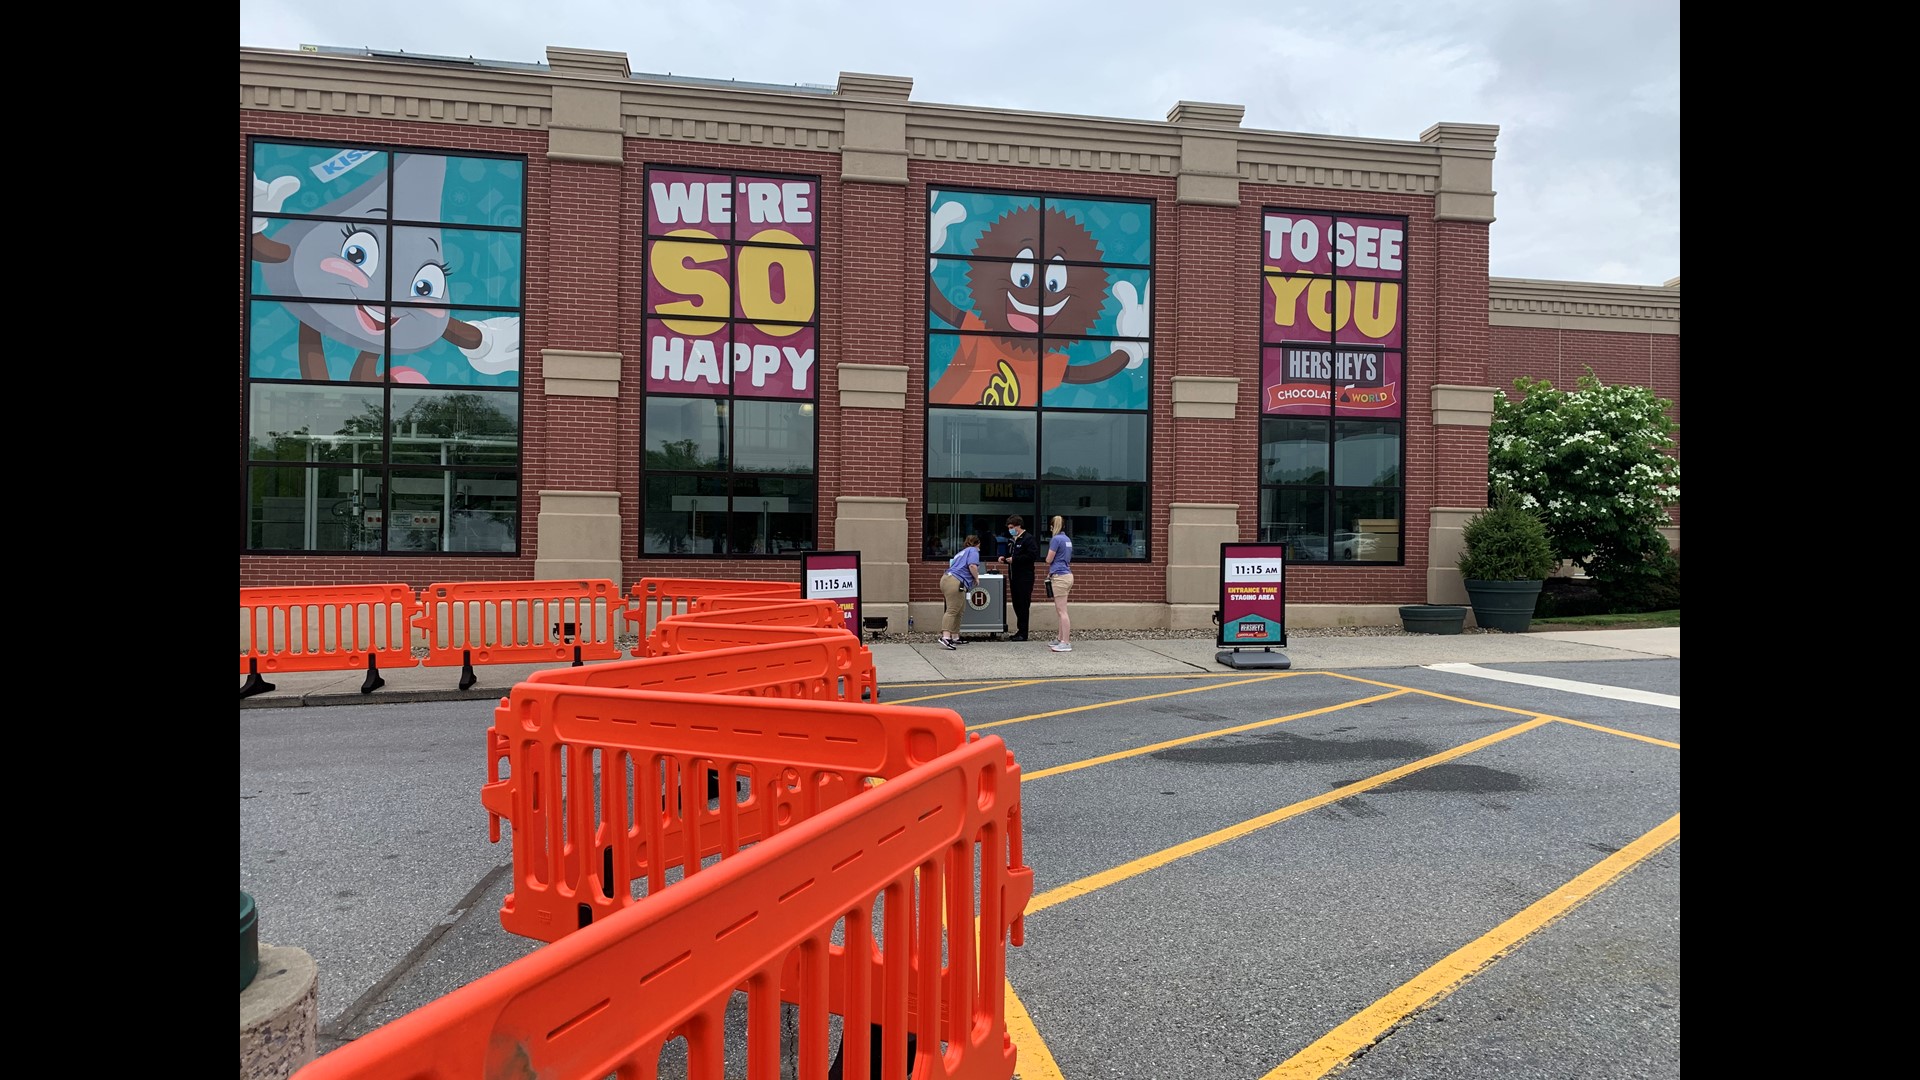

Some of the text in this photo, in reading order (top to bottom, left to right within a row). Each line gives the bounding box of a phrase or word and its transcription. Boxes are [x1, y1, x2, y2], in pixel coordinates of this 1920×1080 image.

[651, 182, 812, 223] WE'RE
[1264, 215, 1403, 271] TO SEE
[651, 229, 815, 336] SO
[1264, 266, 1399, 338] YOU
[651, 336, 815, 390] HAPPY
[1289, 350, 1377, 381] HERSHEY'S
[1352, 392, 1388, 403] WORLD
[814, 579, 839, 590] 11:15
[1235, 565, 1262, 574] 11:15
